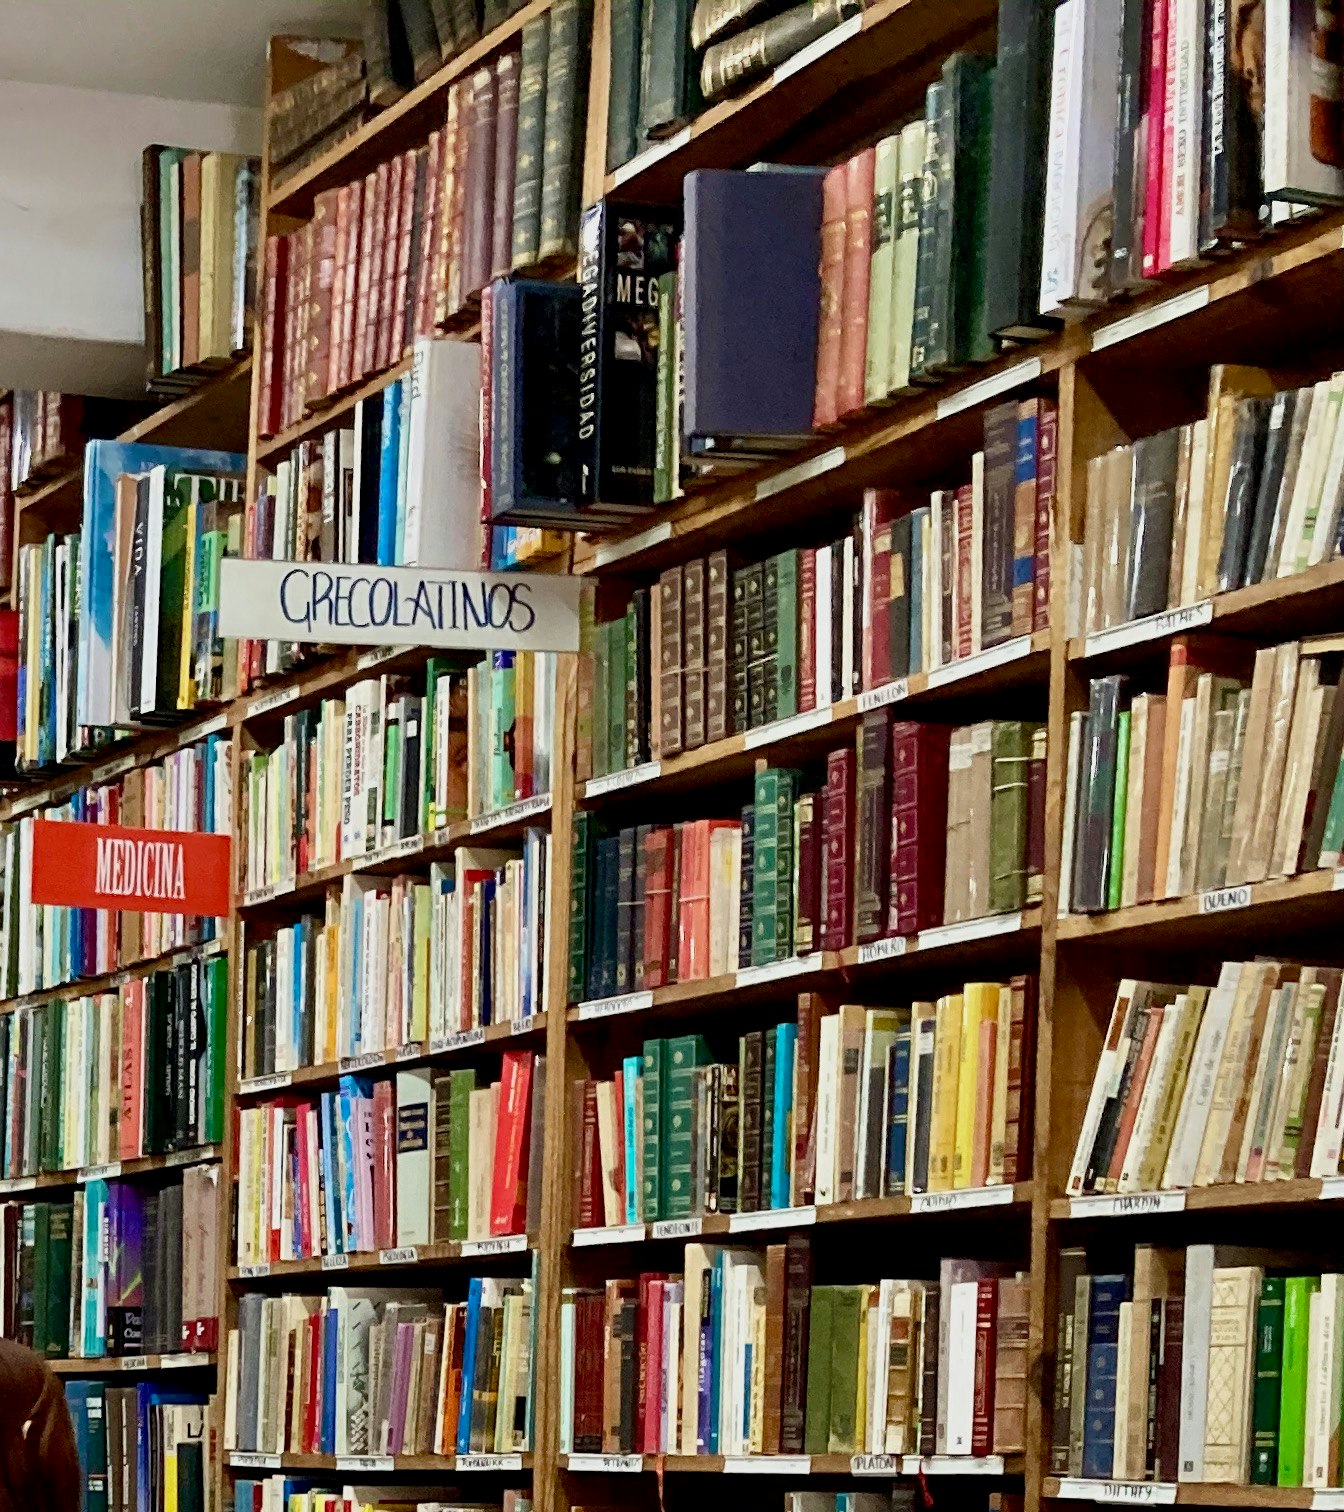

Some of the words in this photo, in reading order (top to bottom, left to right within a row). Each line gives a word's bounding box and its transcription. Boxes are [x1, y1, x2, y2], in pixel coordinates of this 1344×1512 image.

[578, 252, 599, 439] EGADIVERSIDAD
[280, 569, 535, 633] GRECOLATINOS
[95, 838, 185, 900] MEDICINA
